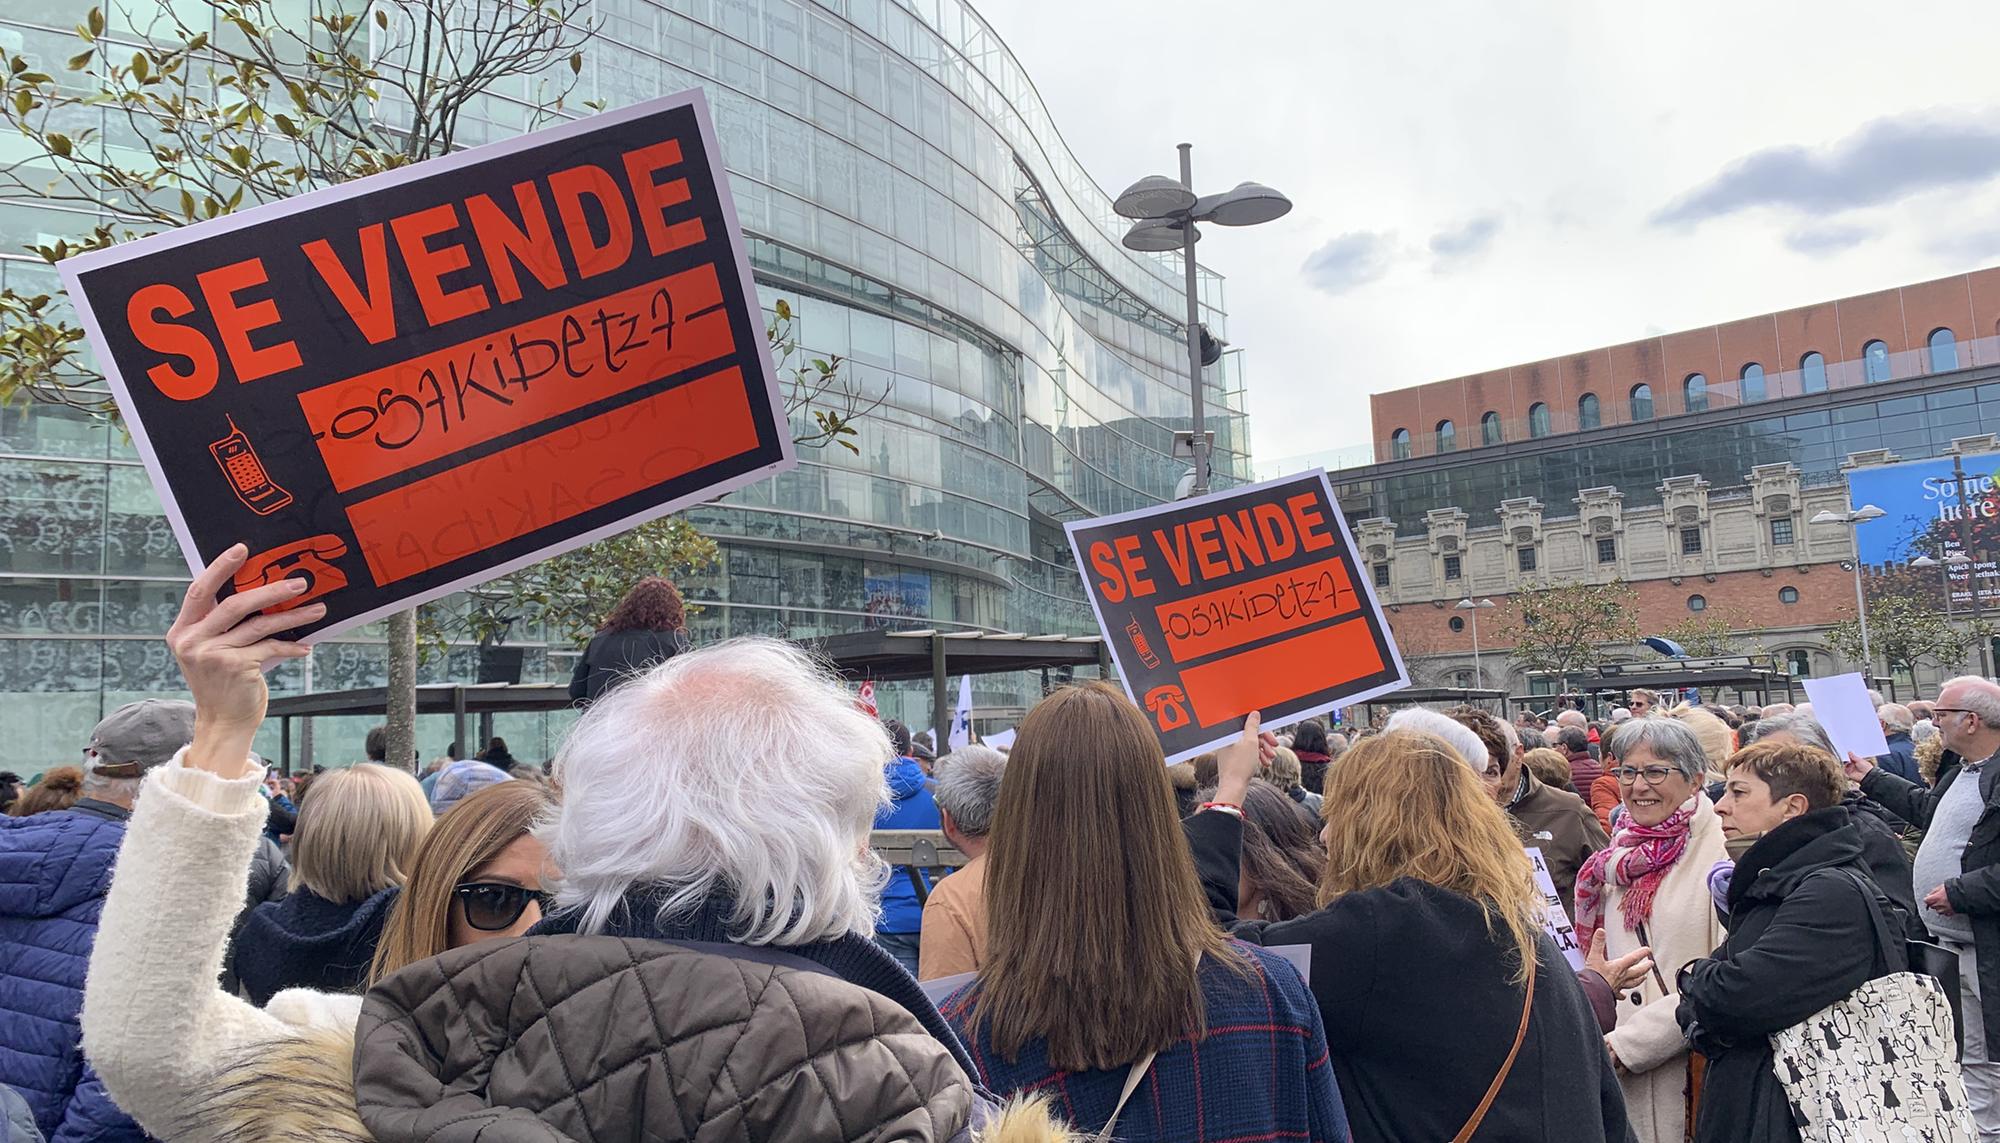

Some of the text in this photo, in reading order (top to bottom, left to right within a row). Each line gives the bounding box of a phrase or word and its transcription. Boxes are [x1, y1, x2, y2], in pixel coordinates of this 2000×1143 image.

[126, 138, 708, 402] SE VENDE
[1922, 476, 1994, 500] Some
[1937, 500, 1999, 522] here
[1088, 491, 1335, 604] SE VENDE
[1944, 540, 1961, 548] Ben
[1948, 561, 1998, 572] Apichtpong
